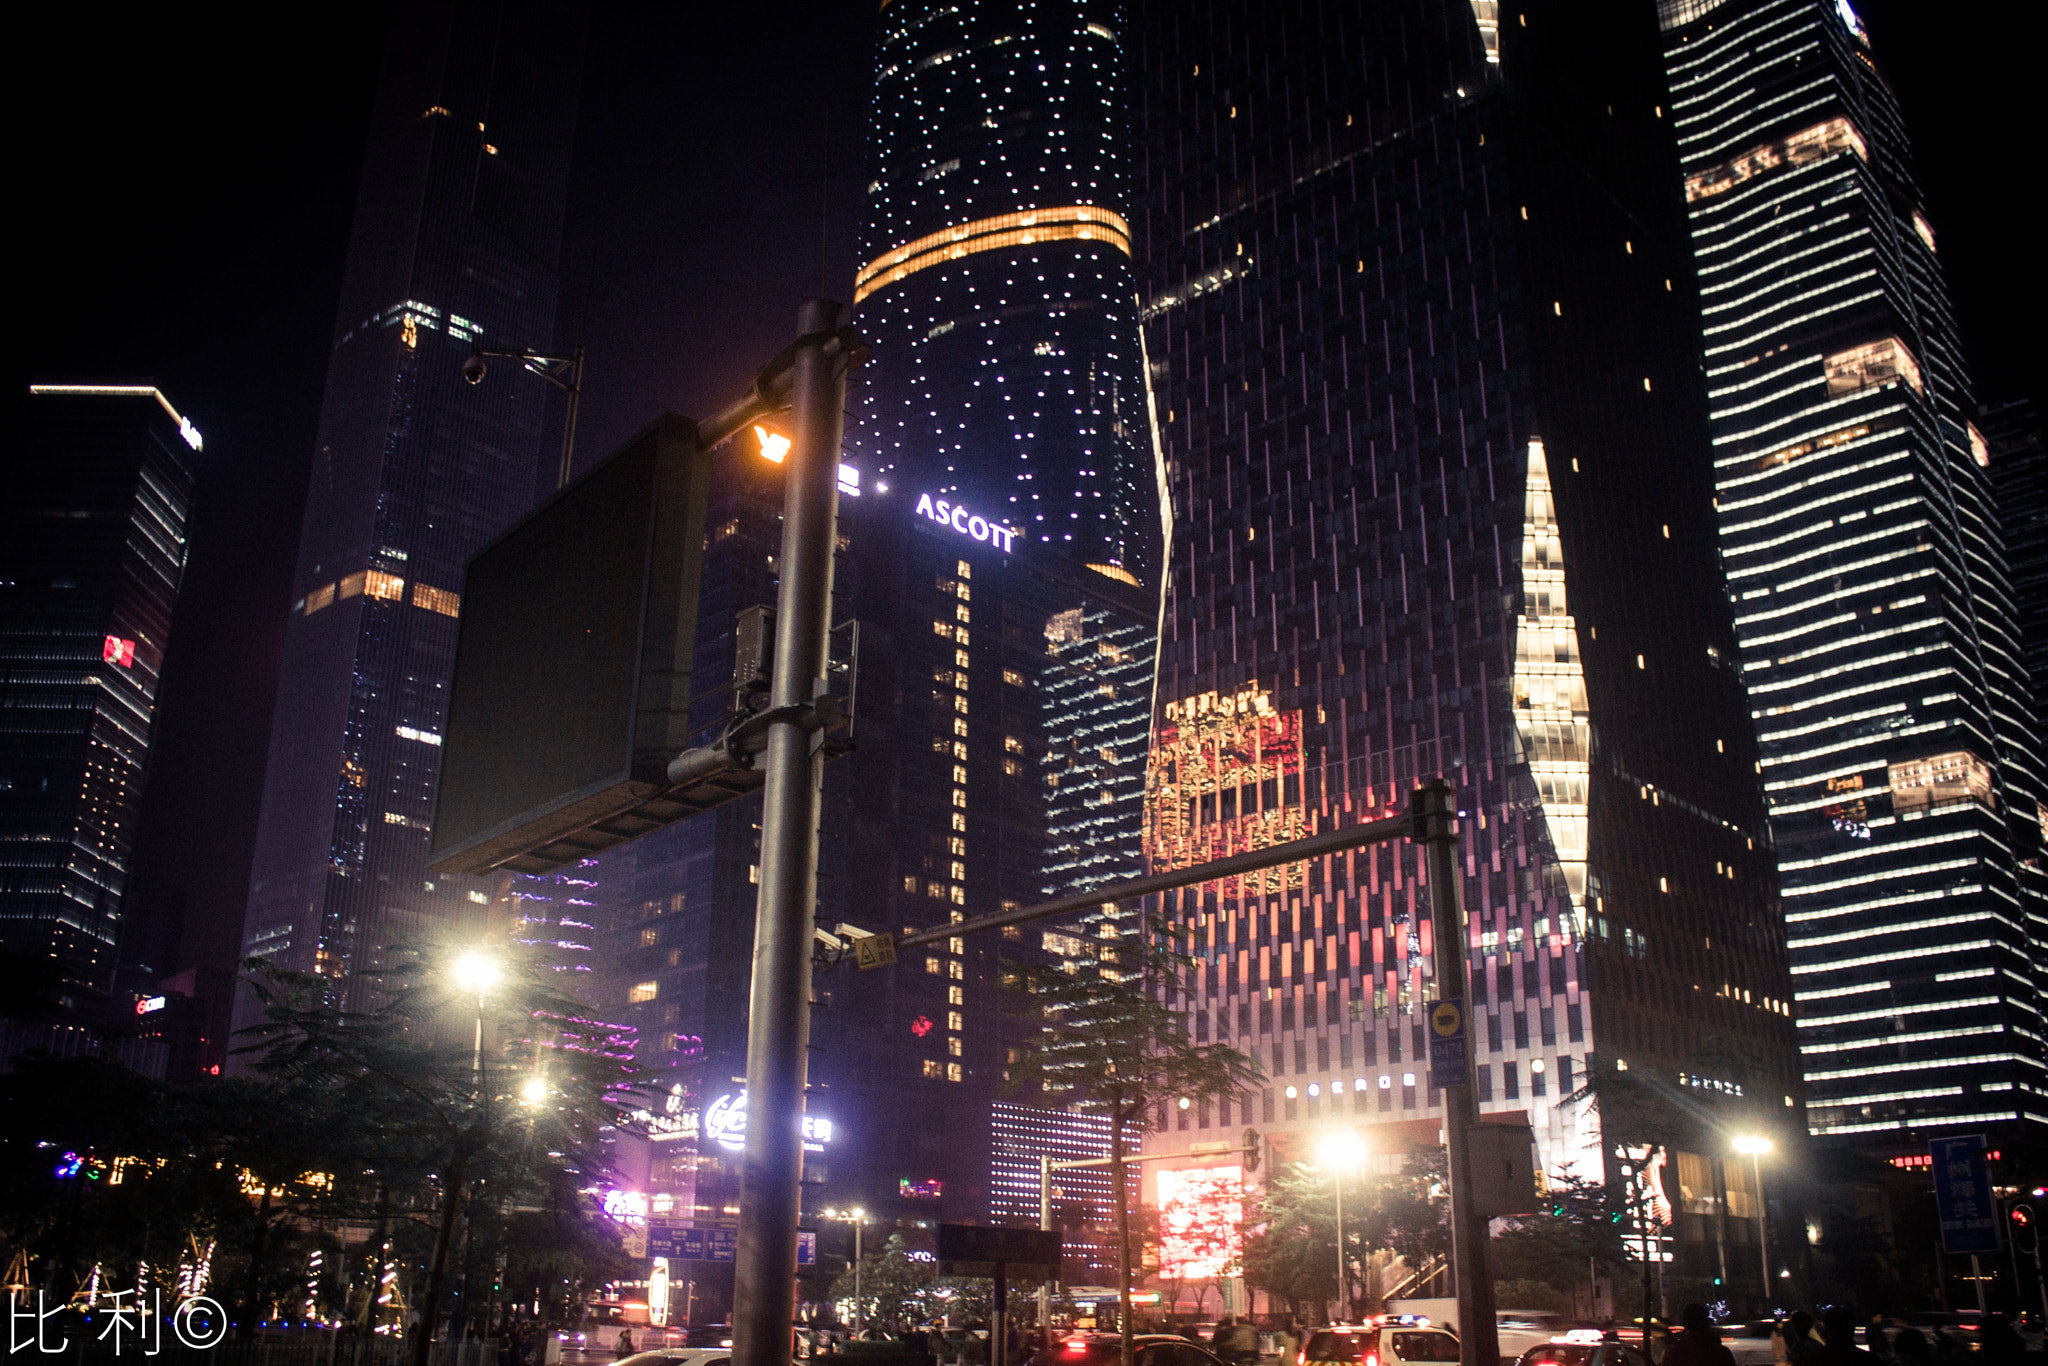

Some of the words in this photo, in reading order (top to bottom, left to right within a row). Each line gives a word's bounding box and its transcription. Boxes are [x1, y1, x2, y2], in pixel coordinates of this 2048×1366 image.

[915, 493, 1015, 553] ASCOTT
[1434, 1042, 1463, 1057] 0474
[1945, 1141, 1979, 1218] 广州海关
